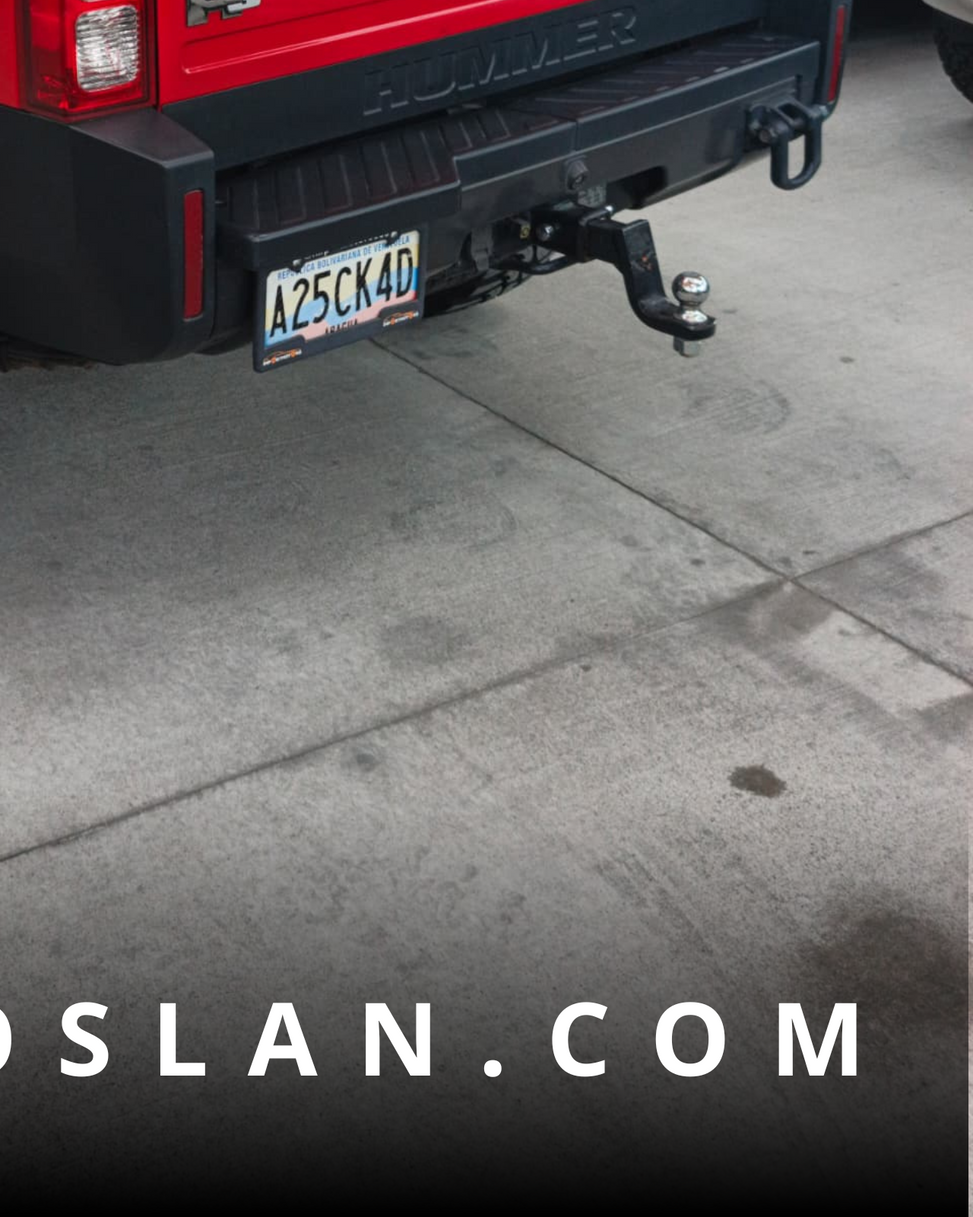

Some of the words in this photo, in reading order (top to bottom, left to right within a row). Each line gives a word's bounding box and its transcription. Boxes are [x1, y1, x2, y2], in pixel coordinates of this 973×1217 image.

[363, 5, 638, 116] HUMMER
[270, 247, 414, 338] A25CK4D
[317, 250, 361, 269] BOLIVARIANA
[363, 245, 373, 256] DE
